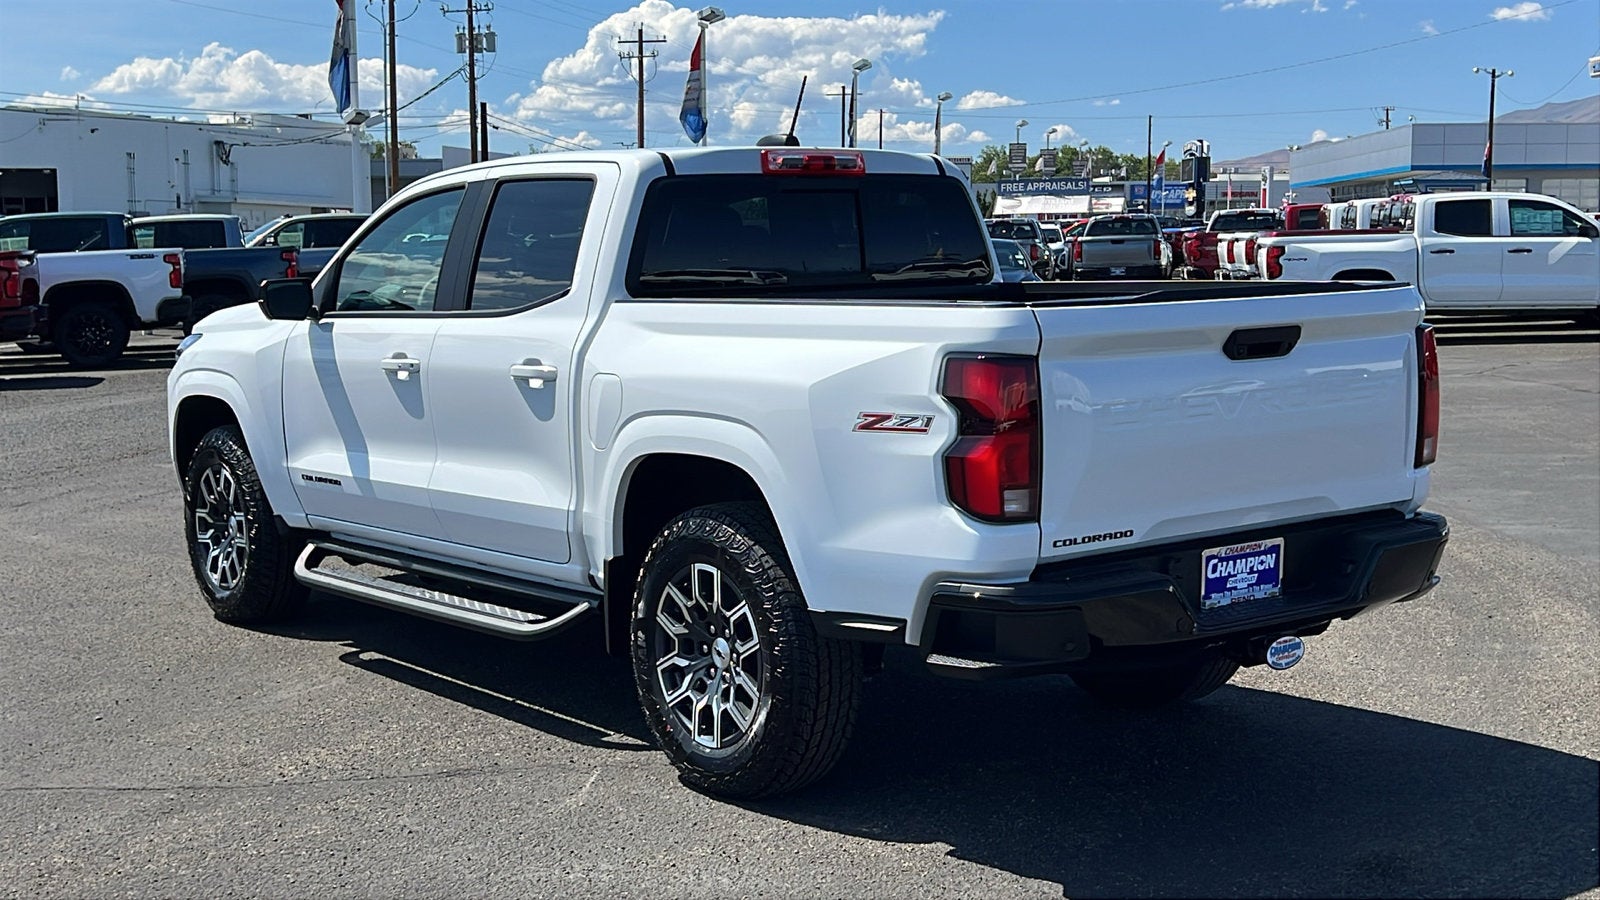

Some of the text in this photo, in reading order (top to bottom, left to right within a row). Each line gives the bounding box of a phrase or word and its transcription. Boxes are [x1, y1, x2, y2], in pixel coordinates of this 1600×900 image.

[1001, 181, 1087, 192] FREE APPRAISALS!
[852, 412, 936, 435] Z71
[1053, 530, 1134, 548] COLORADO
[1225, 542, 1264, 555] CHAMPION
[1207, 553, 1276, 579] CHAMPION
